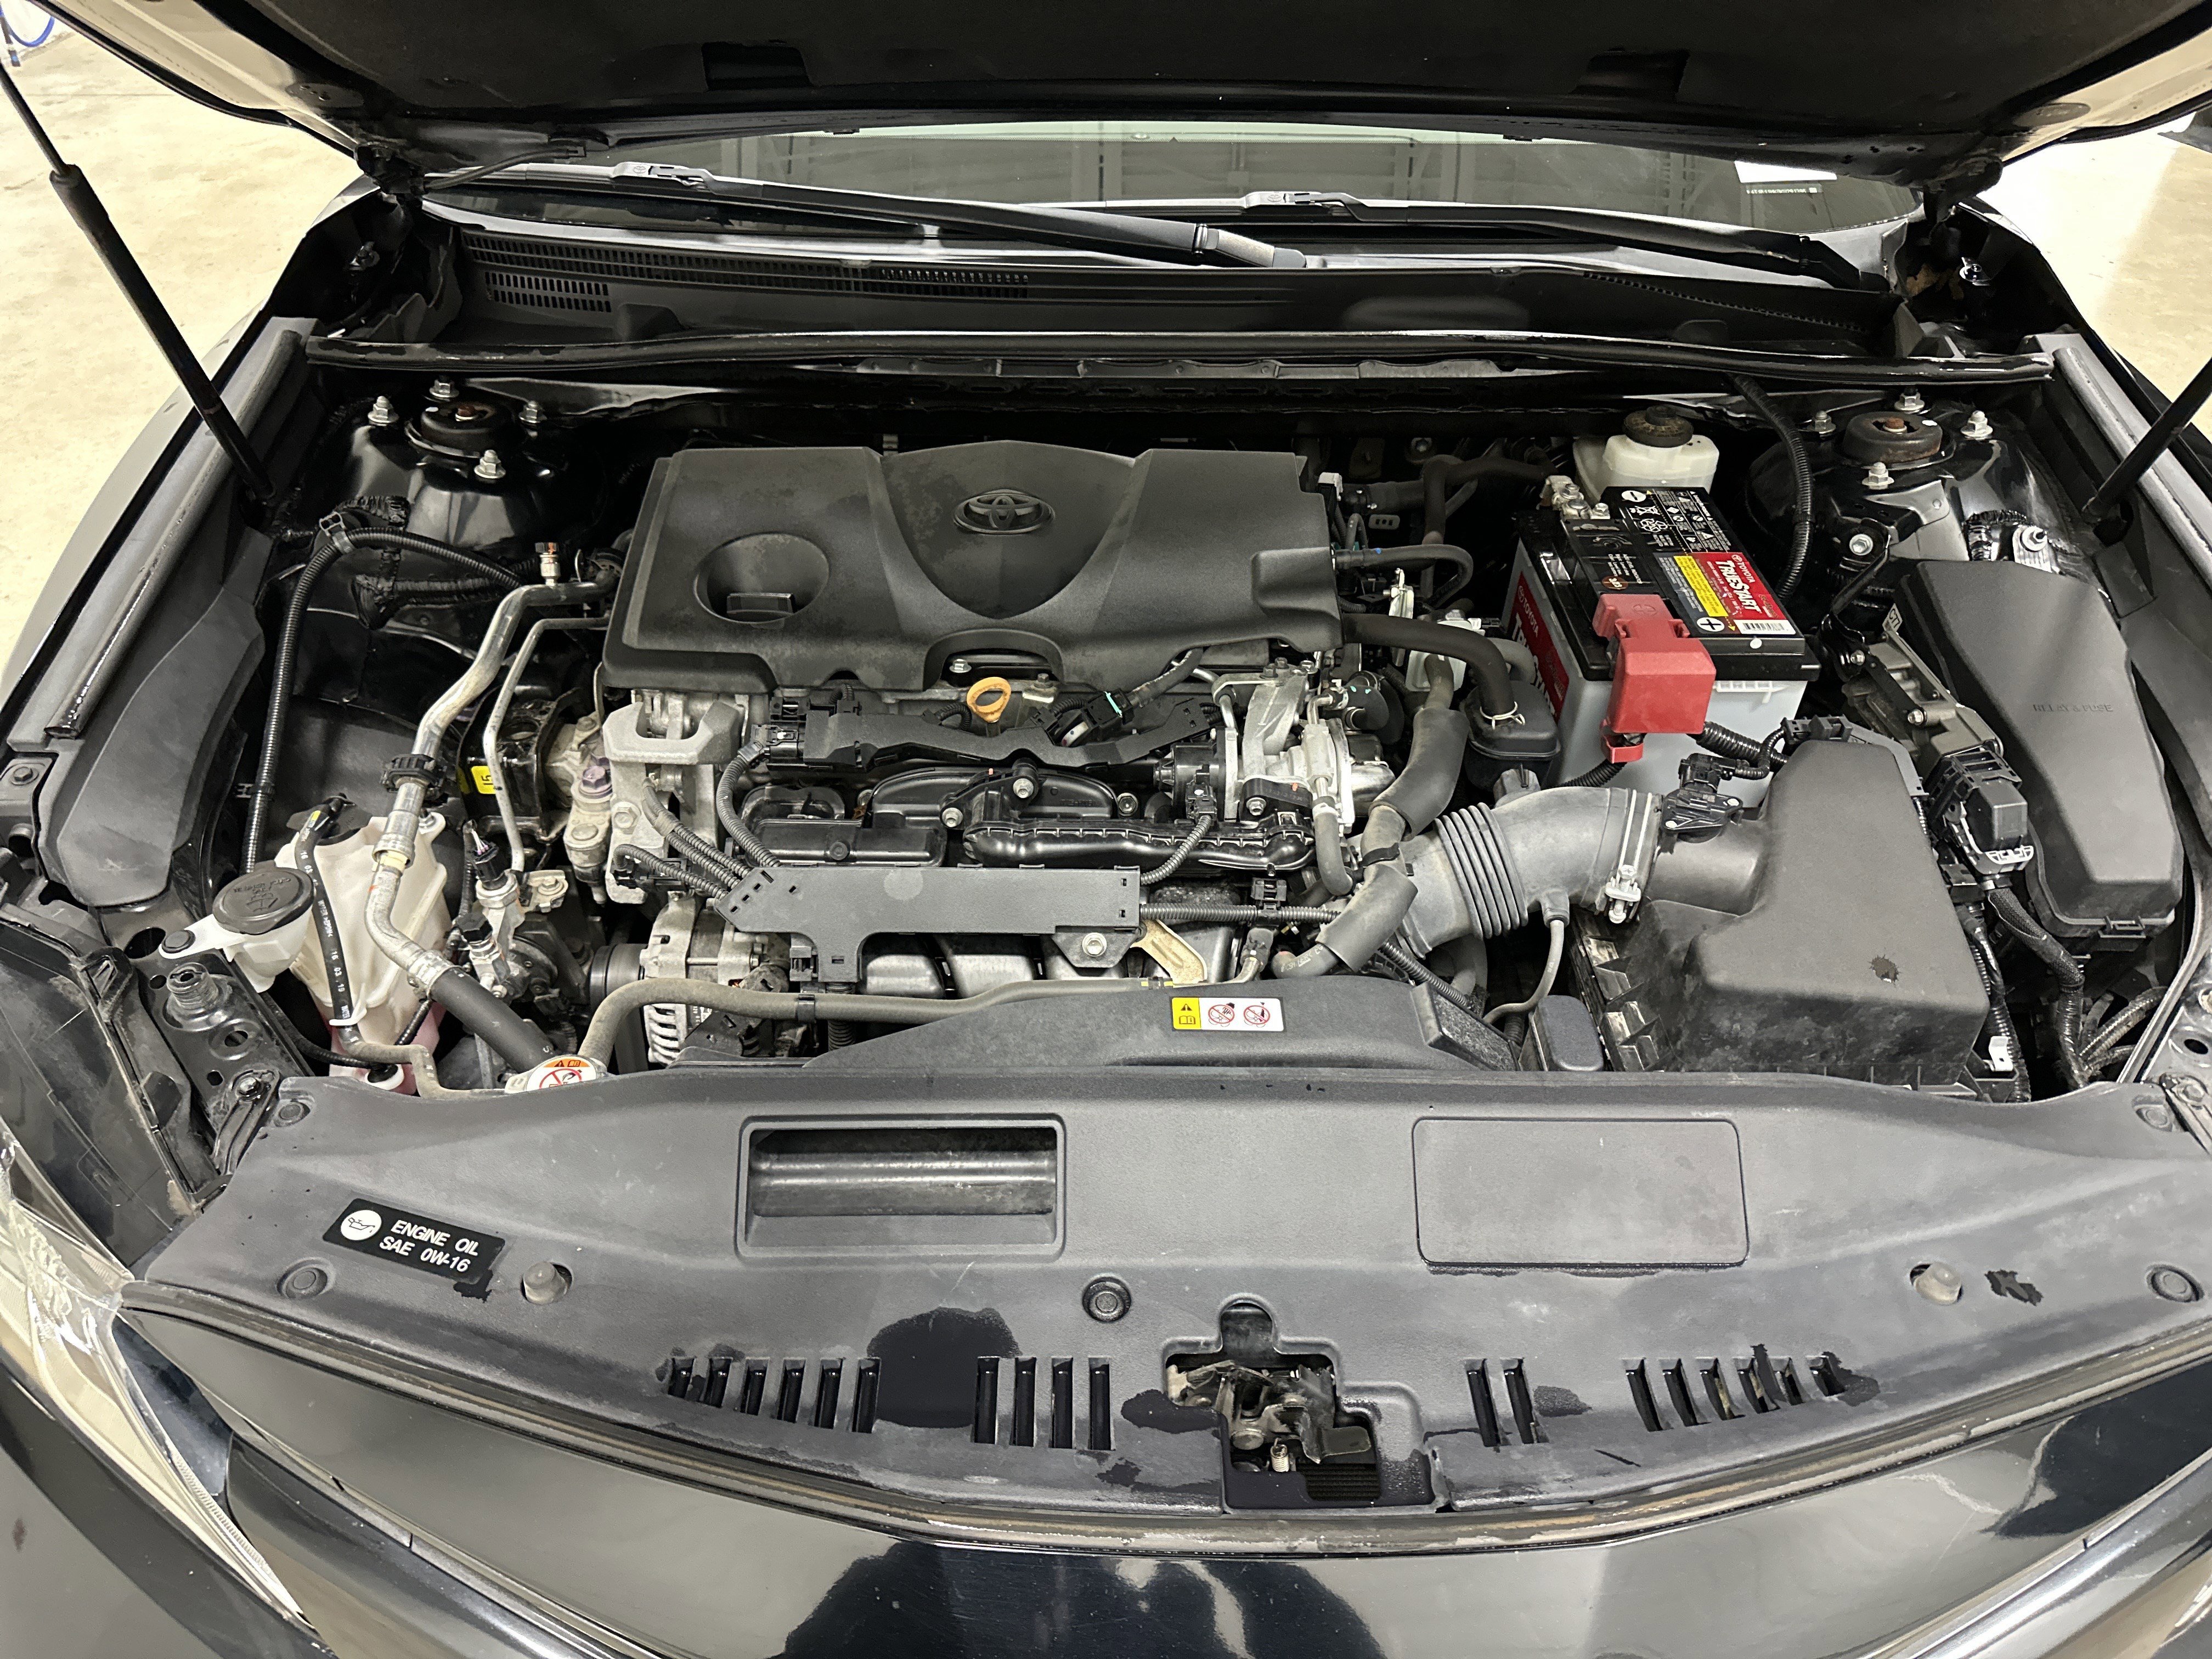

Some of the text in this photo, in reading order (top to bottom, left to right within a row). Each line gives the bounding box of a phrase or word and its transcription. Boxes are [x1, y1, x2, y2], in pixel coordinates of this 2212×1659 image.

[1737, 562, 1756, 583] TOYOTA
[1523, 597, 1539, 637] TOYOTA
[1889, 608, 1900, 628] C77
[2082, 704, 2114, 712] FUSE
[391, 1220, 479, 1256] ENGINE OIL
[379, 1236, 471, 1272] SAE 0W-16
